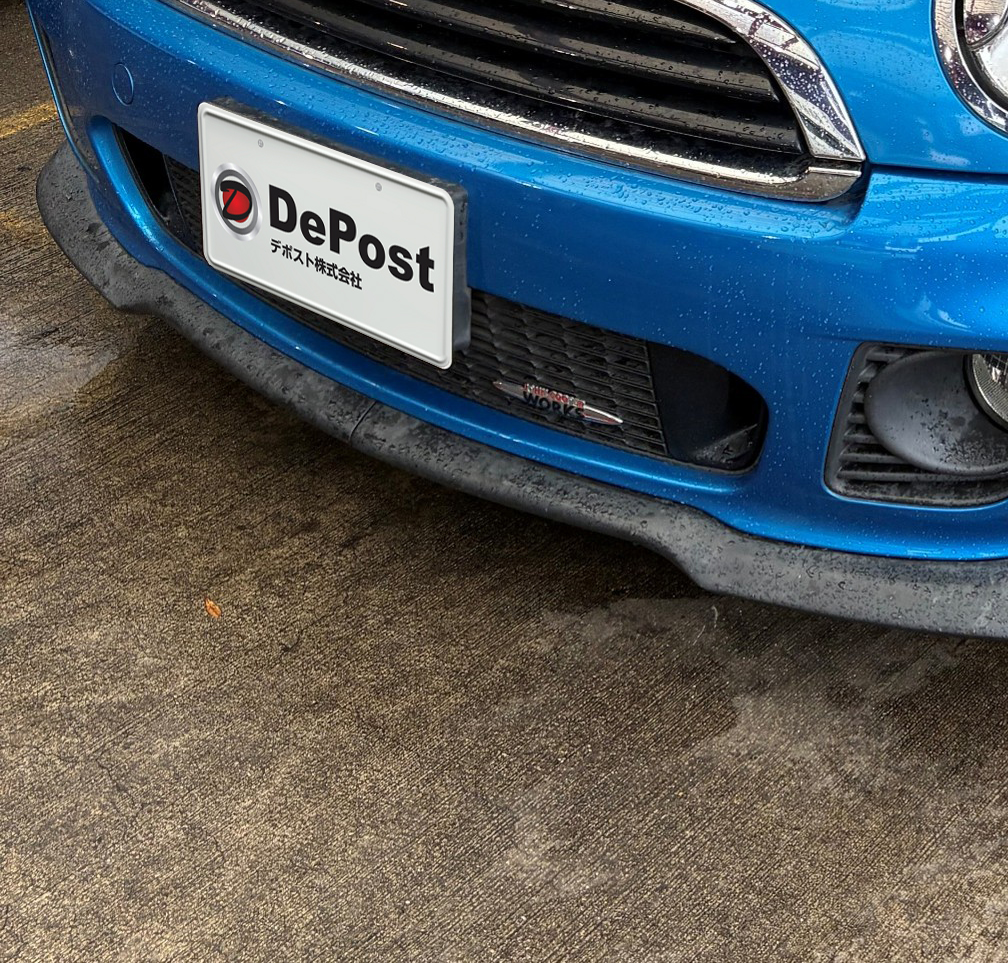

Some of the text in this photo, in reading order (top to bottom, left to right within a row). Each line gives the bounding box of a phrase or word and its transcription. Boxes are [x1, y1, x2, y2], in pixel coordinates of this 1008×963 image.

[268, 184, 435, 293] DePost
[270, 238, 363, 290] デポスト株式会社
[523, 391, 585, 418] WORKS
